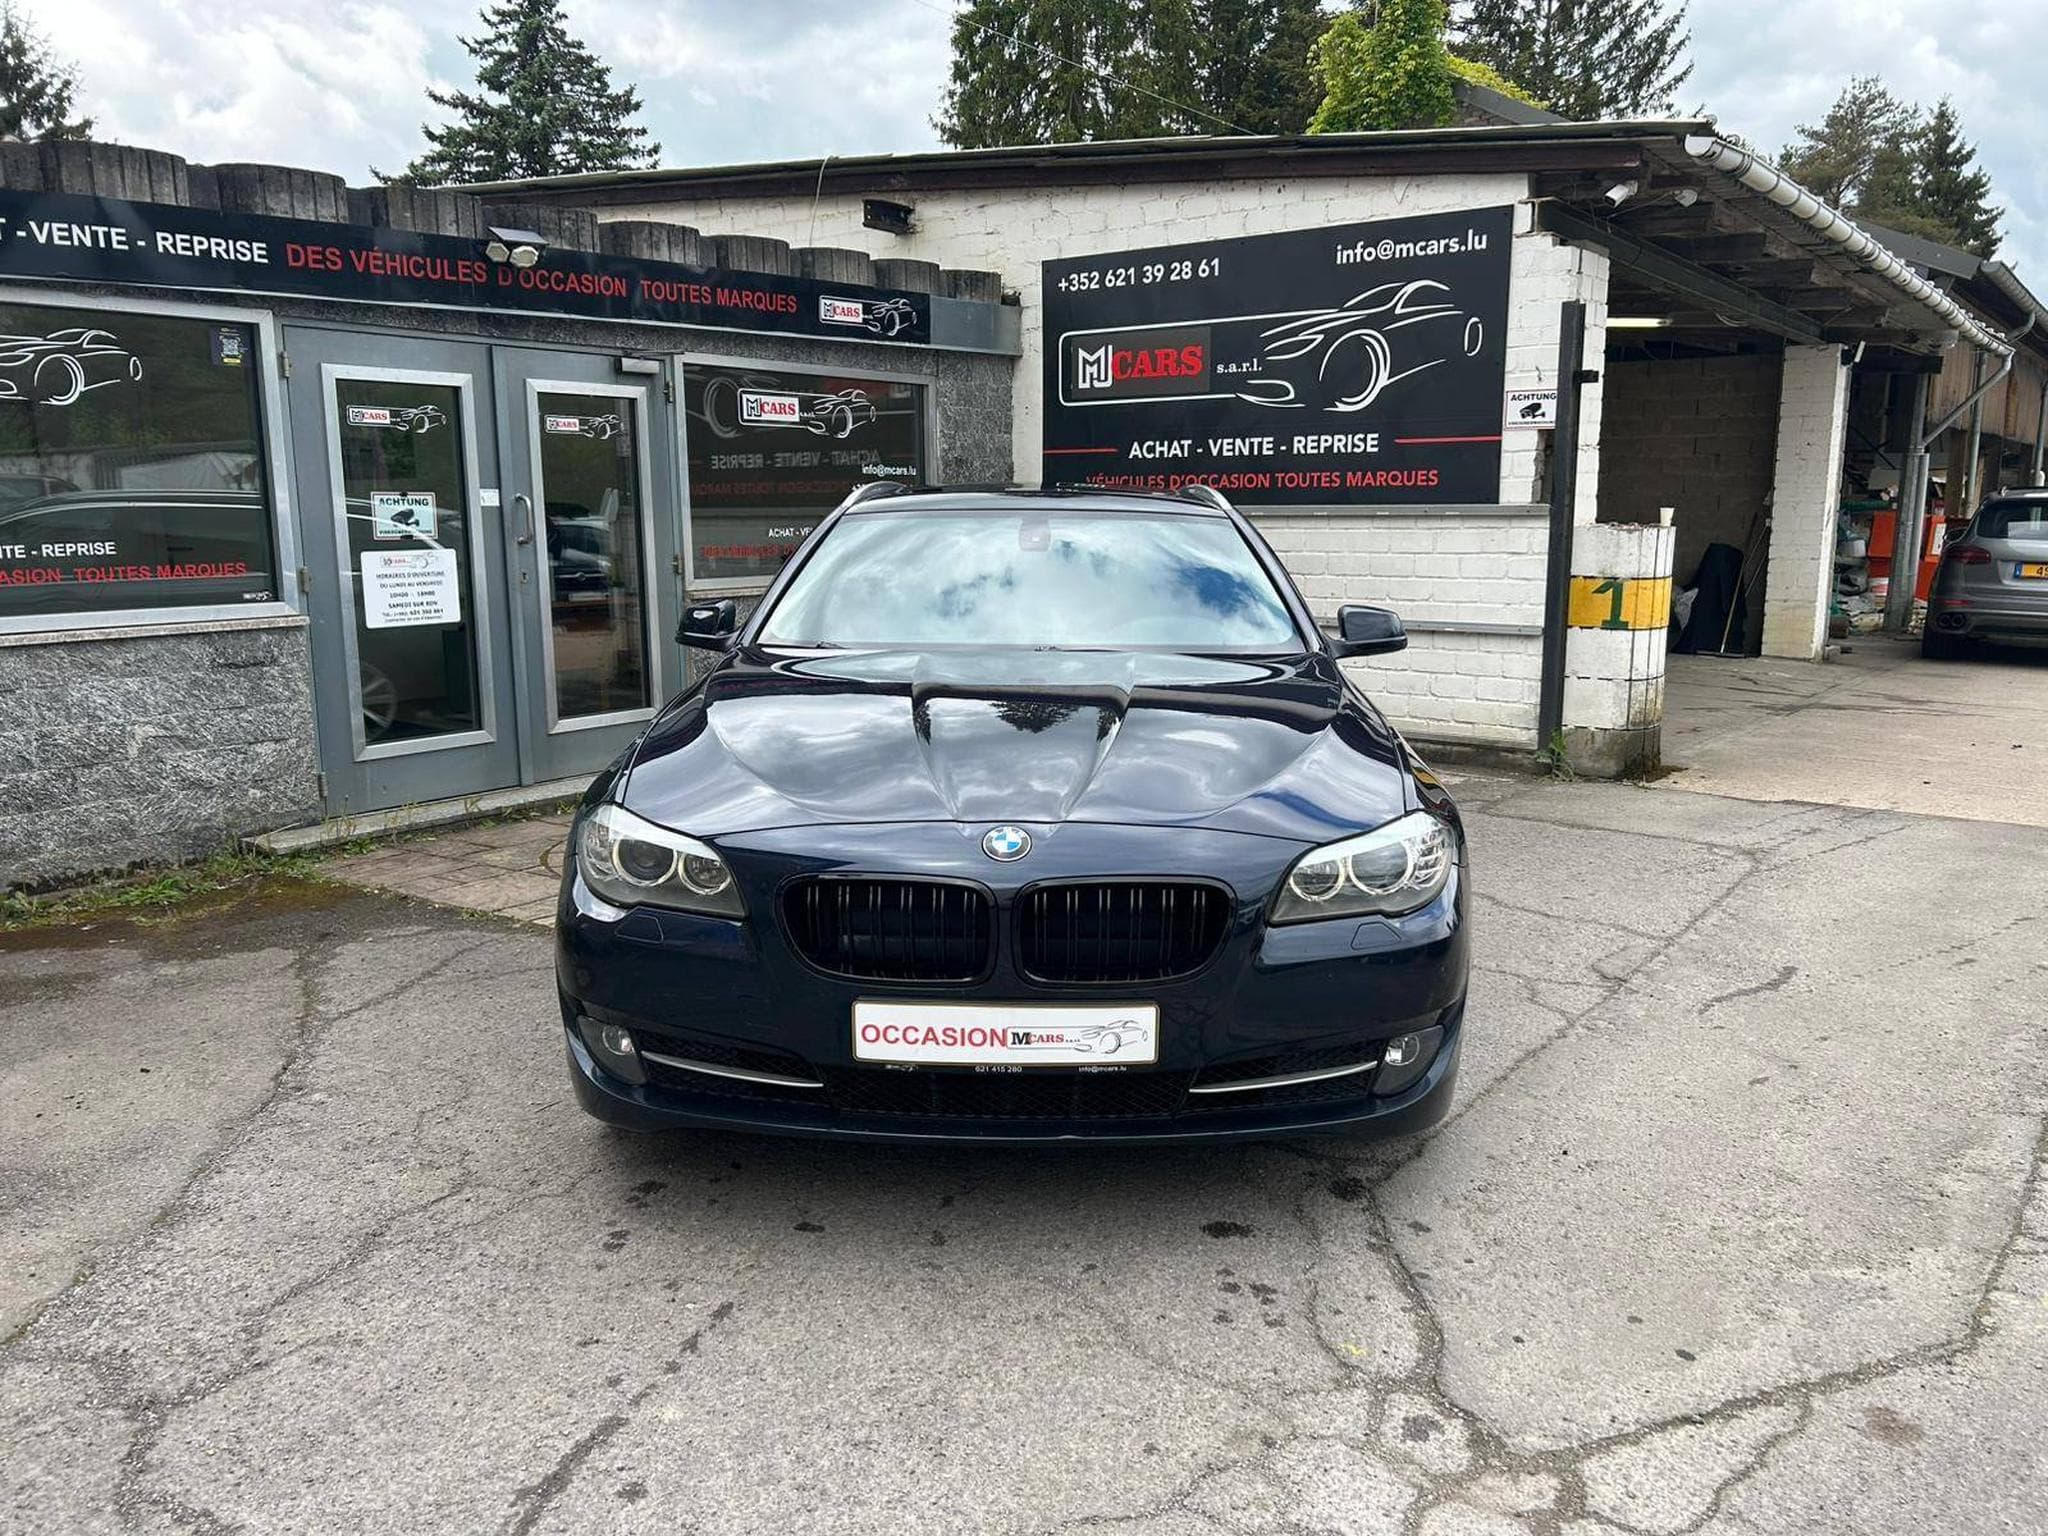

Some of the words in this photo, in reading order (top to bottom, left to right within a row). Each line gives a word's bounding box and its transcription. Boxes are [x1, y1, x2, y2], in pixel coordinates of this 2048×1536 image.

[1335, 229, 1489, 265] info@mcars.lu
[156, 232, 269, 264] REPRISE
[286, 243, 343, 271] DES
[349, 244, 487, 284] VÉHICULES
[498, 265, 627, 298] DOCCASION
[640, 279, 712, 305] TOUTES
[717, 287, 798, 314] MARQUES
[1058, 271, 1100, 292] +352
[1105, 267, 1136, 288] 621
[1142, 264, 1165, 284] 39
[1170, 261, 1192, 281] 28
[1198, 257, 1221, 278] 61
[1216, 358, 1263, 373] s.a.r.l.
[1511, 392, 1557, 402] ACHTUNG
[1129, 439, 1193, 460] ACHAT
[1208, 436, 1274, 458] VENTE
[1293, 433, 1380, 456] REPRISE
[862, 463, 917, 476] info@mcars.lu
[1170, 472, 1270, 490] D'OCCASION
[1275, 471, 1341, 488] TOUTES
[1345, 469, 1439, 487] MARQUES
[379, 497, 429, 506] ACHTUNG
[768, 528, 794, 538] ACHAT
[41, 541, 117, 557] REPRISE
[73, 564, 150, 584] TOUTES
[156, 561, 248, 578] MARQUES
[1590, 579, 1630, 628] 1
[861, 1024, 1007, 1047] OCCASION
